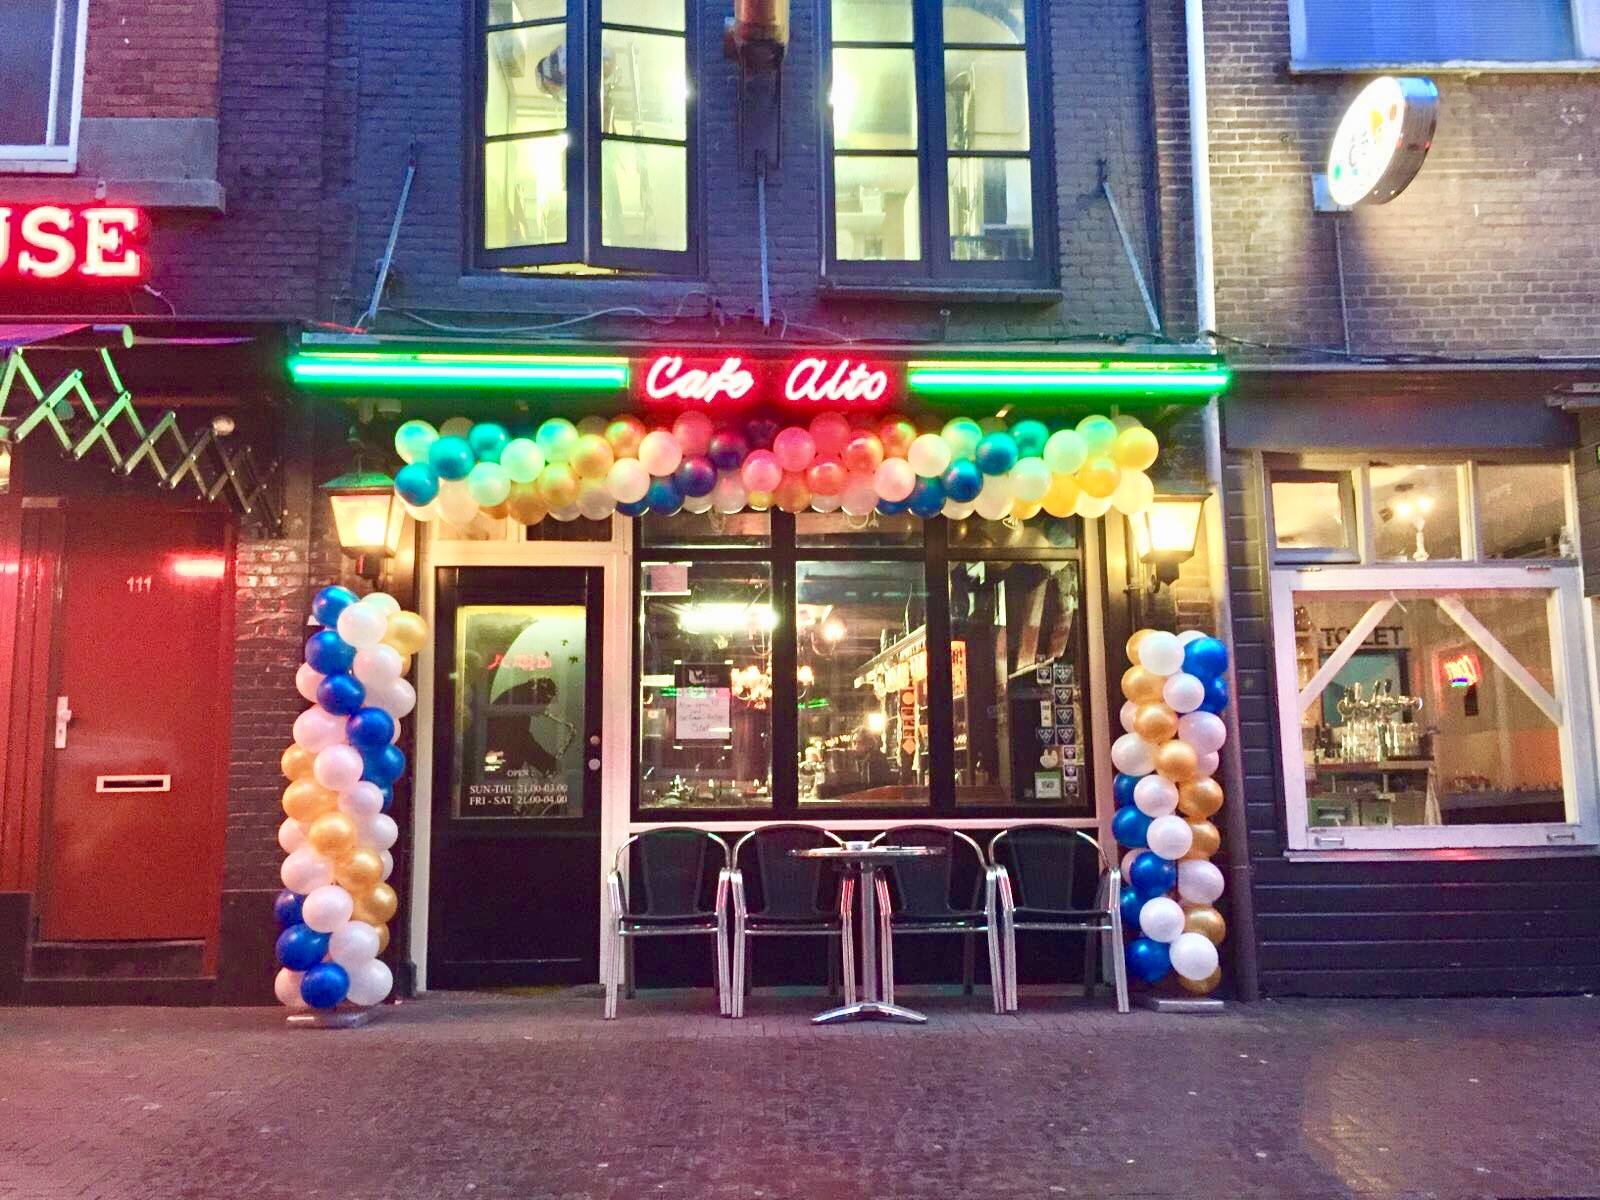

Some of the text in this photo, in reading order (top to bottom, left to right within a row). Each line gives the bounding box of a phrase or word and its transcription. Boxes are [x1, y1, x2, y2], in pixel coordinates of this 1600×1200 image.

[0, 205, 141, 278] SE
[126, 575, 152, 592] 111
[469, 796, 486, 806] FRI
[493, 796, 512, 805] SAT
